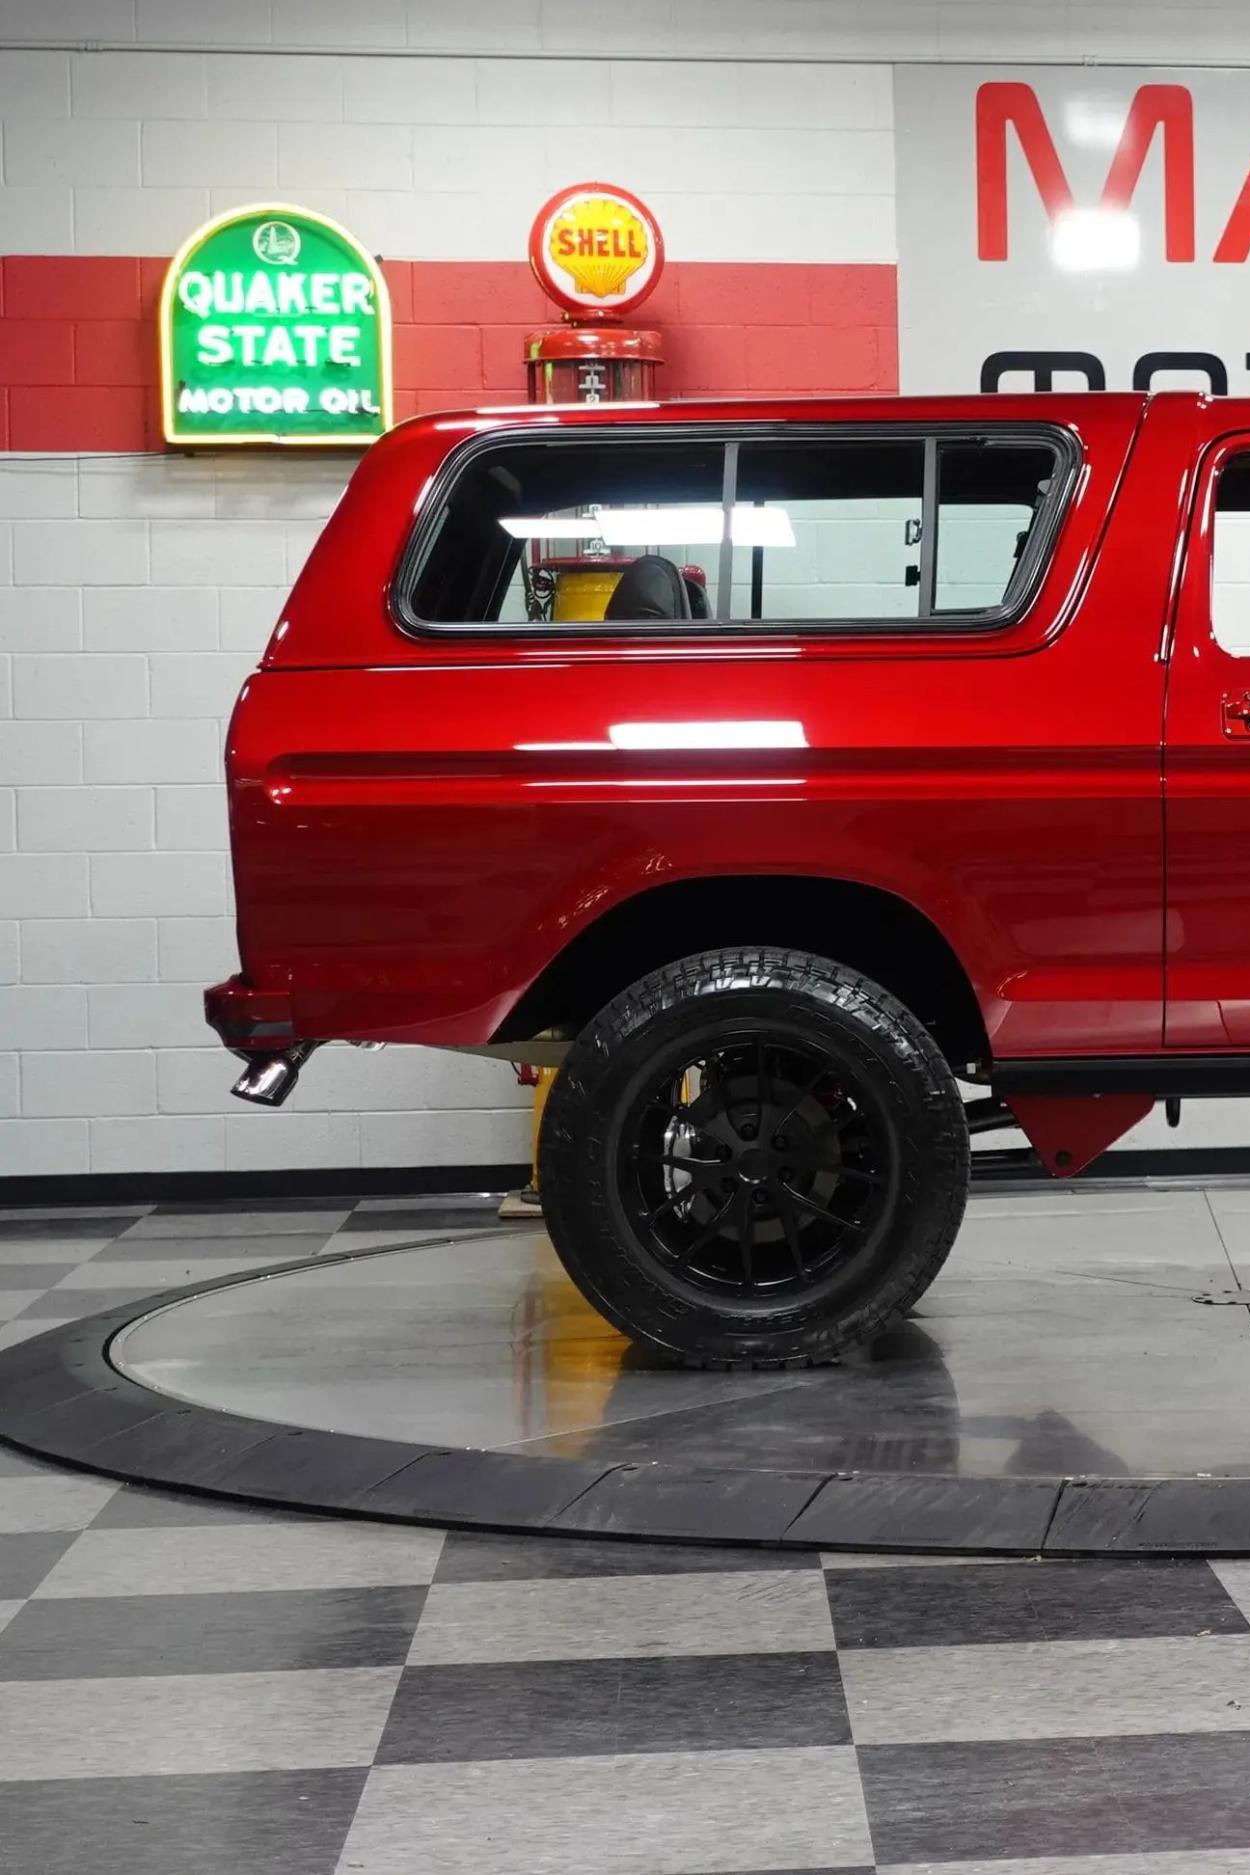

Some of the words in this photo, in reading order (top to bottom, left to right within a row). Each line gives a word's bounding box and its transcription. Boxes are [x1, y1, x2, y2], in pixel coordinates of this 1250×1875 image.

[557, 228, 642, 258] SHELL
[178, 270, 375, 319] QUAKER
[197, 324, 362, 367] STATE
[178, 387, 309, 414] MOTOR
[319, 387, 381, 414] OIL
